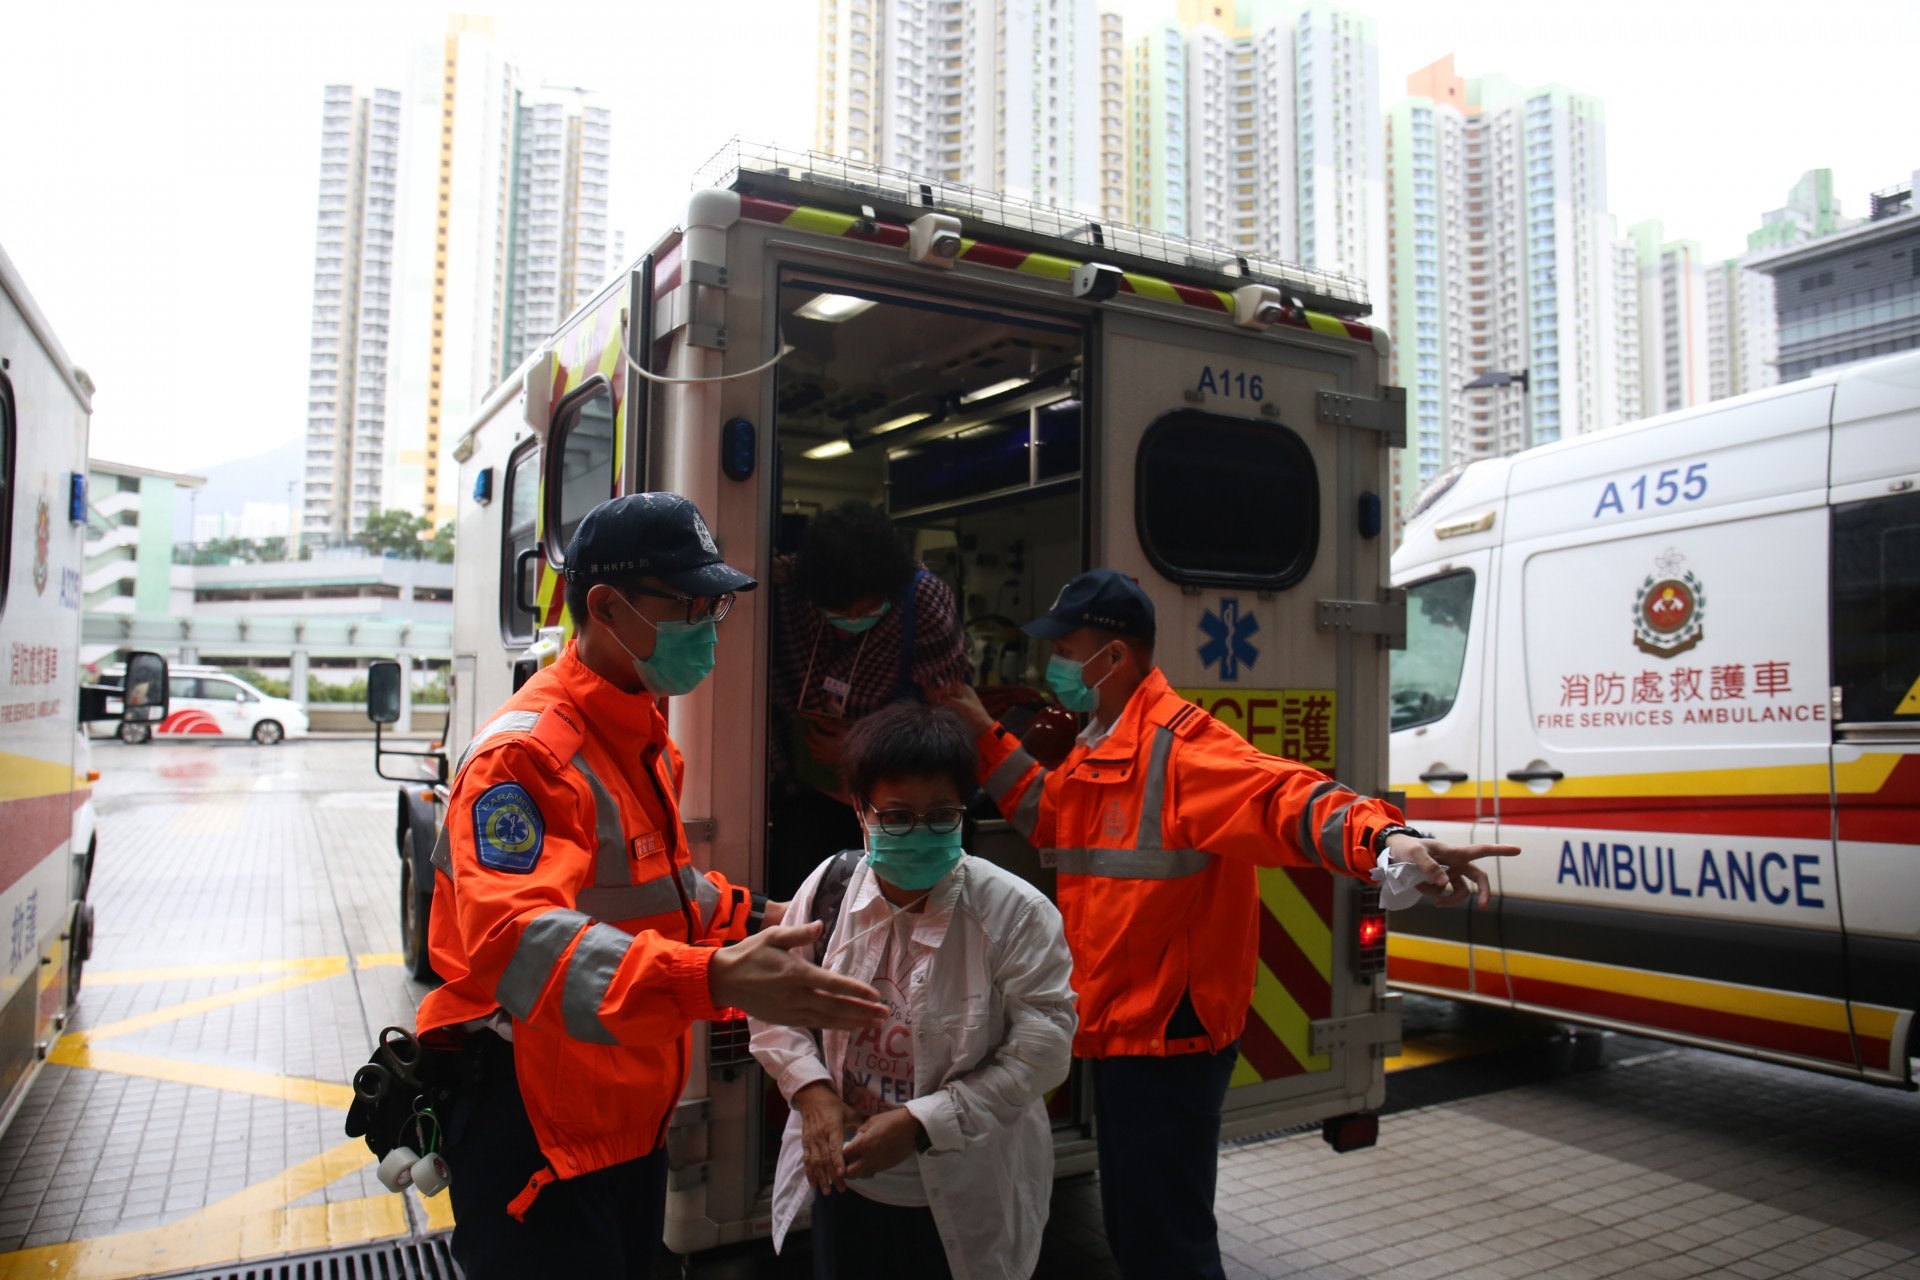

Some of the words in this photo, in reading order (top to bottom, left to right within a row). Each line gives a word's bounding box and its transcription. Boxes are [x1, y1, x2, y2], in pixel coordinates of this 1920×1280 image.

[1198, 366, 1263, 402] A116
[1593, 463, 1708, 518] A155
[603, 560, 634, 574] HKFS
[1560, 660, 1791, 708] 消防處救護車
[1537, 713, 1574, 729] FIRE
[1580, 710, 1673, 728] SERVICES
[1683, 704, 1827, 724] AMBULANCE
[1557, 840, 1824, 908] AMBULANCE
[866, 1054, 900, 1073] GOT
